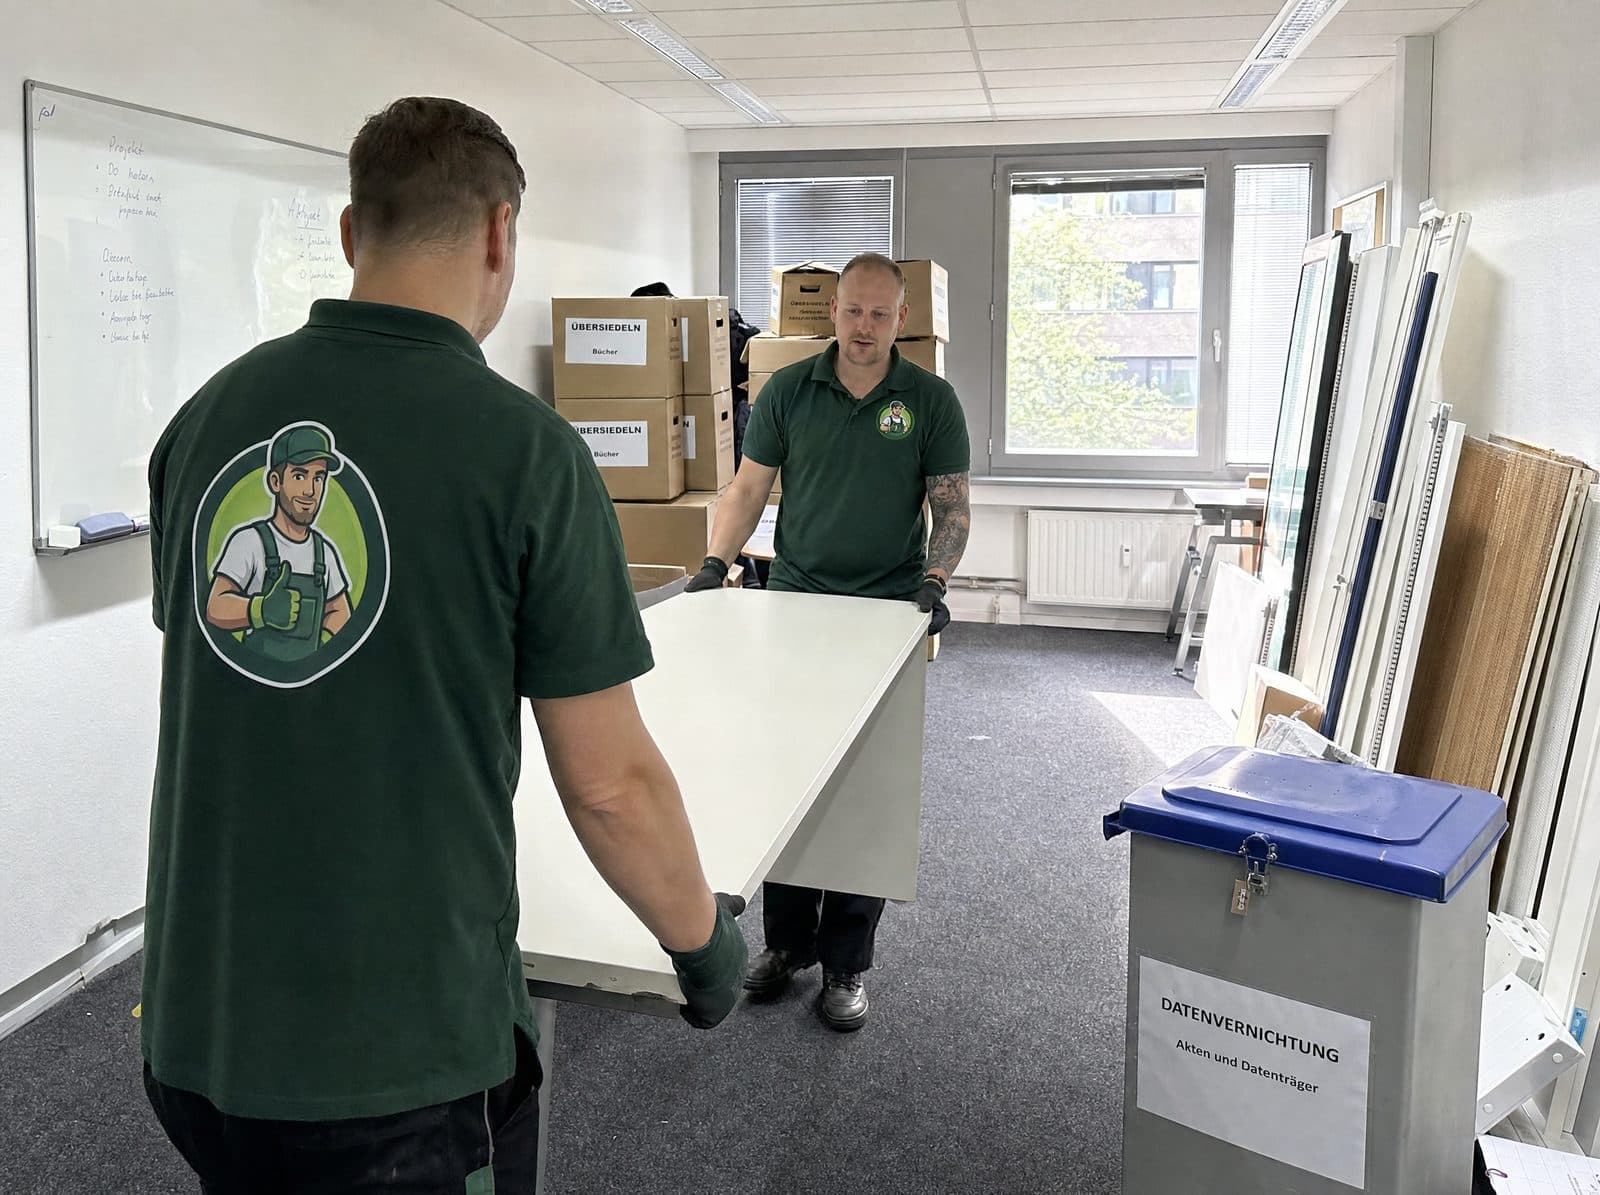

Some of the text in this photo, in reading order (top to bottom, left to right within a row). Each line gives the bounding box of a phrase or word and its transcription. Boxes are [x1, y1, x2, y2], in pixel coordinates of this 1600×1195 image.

[108, 135, 144, 160] Projekt
[571, 322, 641, 332] ÜBERSIEDELN
[592, 348, 618, 356] Bücher
[1161, 997, 1340, 1063] DATENVERNICHTUNG
[1175, 1039, 1319, 1093] Akten und Datenträger
